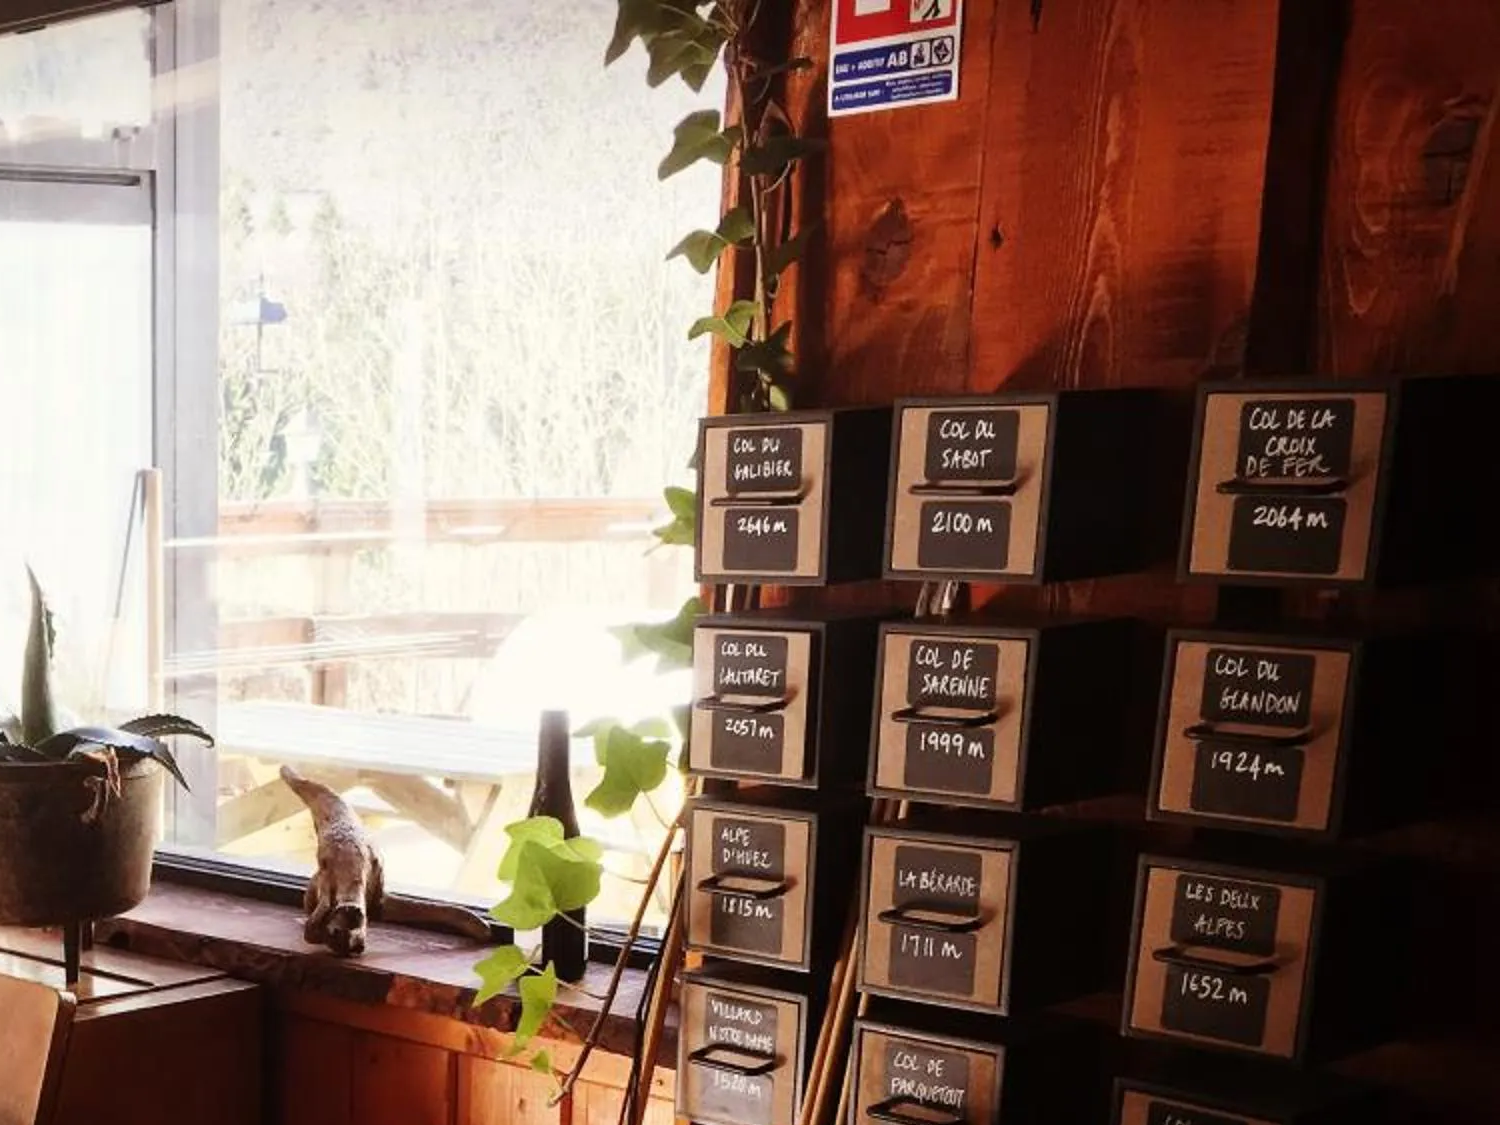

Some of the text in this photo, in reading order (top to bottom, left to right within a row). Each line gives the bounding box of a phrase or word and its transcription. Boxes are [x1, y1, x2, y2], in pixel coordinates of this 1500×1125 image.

[940, 419, 997, 440] COL DU
[1249, 407, 1337, 430] COL DE LA
[733, 437, 781, 454] COL DU
[1265, 435, 1317, 457] CROIX
[942, 447, 993, 469] SABOT
[1245, 453, 1332, 477] DE FER
[733, 459, 794, 481] GALIBIER
[721, 641, 768, 658] COL DU
[915, 645, 975, 671] COL DE
[719, 666, 782, 688] LAUTARET
[1215, 654, 1285, 681] COL DU
[921, 673, 991, 699] SARENNE
[1219, 686, 1302, 715] GLANDON
[721, 827, 751, 847] ALPE
[723, 847, 773, 869] D'HUEZ
[898, 869, 917, 889] LA
[1185, 883, 1261, 911] LES DEUX
[1194, 913, 1247, 940] ALPES
[711, 999, 764, 1025] VILLARD
[893, 1051, 945, 1077] COL DE
